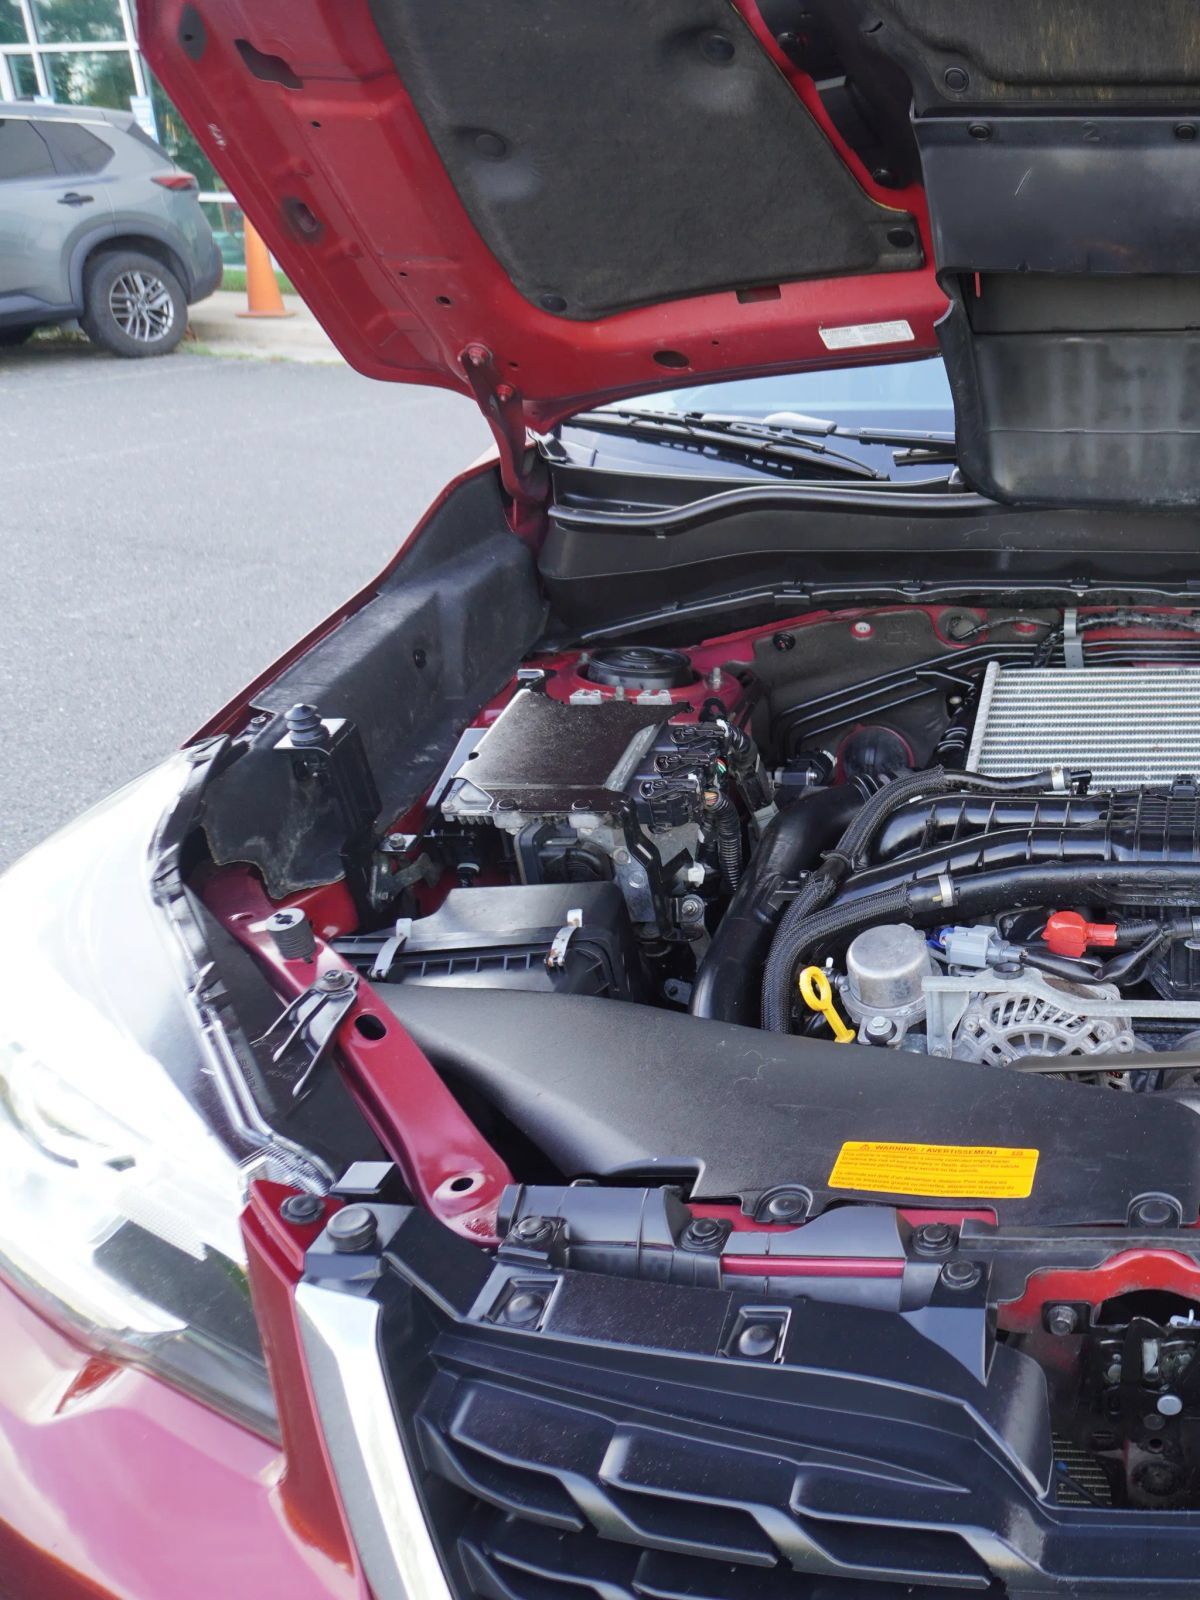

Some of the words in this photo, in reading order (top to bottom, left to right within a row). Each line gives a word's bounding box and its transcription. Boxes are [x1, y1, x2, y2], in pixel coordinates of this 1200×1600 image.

[1081, 121, 1100, 142] 2
[875, 1144, 916, 1152] WARNING
[926, 1147, 998, 1155] AVERTISSEMENT
